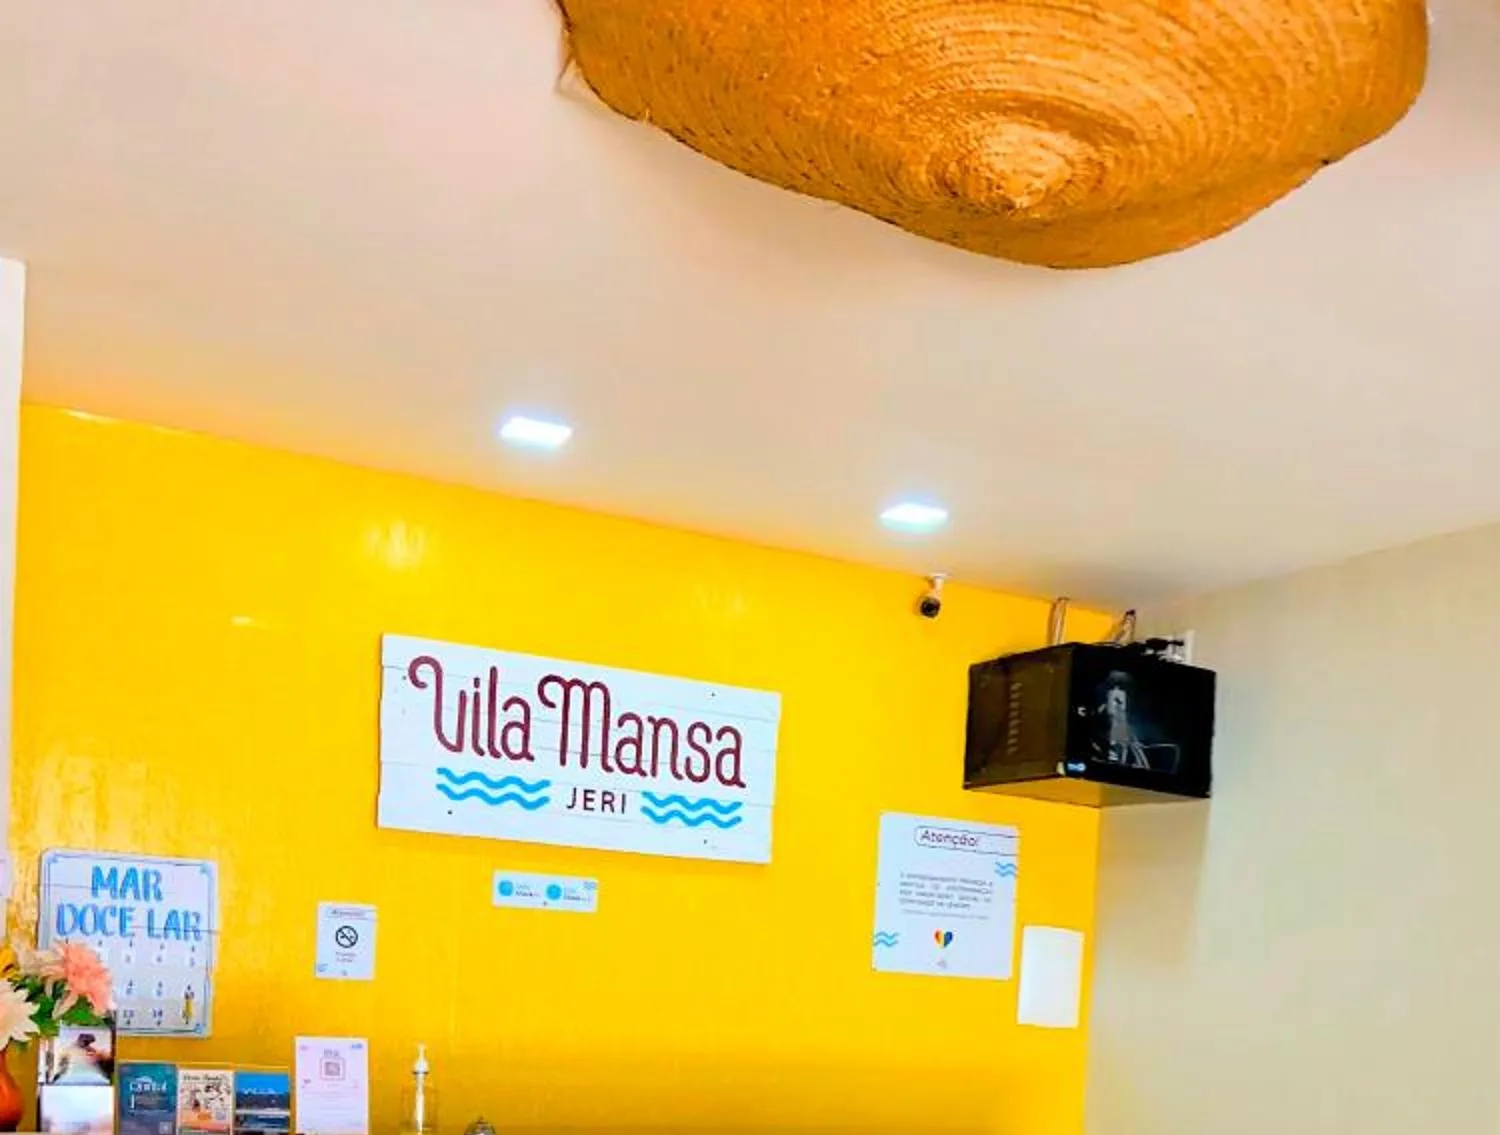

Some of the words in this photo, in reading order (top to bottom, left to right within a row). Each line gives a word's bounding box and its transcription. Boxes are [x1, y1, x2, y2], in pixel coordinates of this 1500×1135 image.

[408, 655, 535, 762] Vila
[537, 674, 747, 788] Mansa
[566, 787, 627, 815] JERI
[91, 864, 164, 902] MAR
[56, 902, 137, 939] DOCE
[147, 907, 204, 942] LAR
